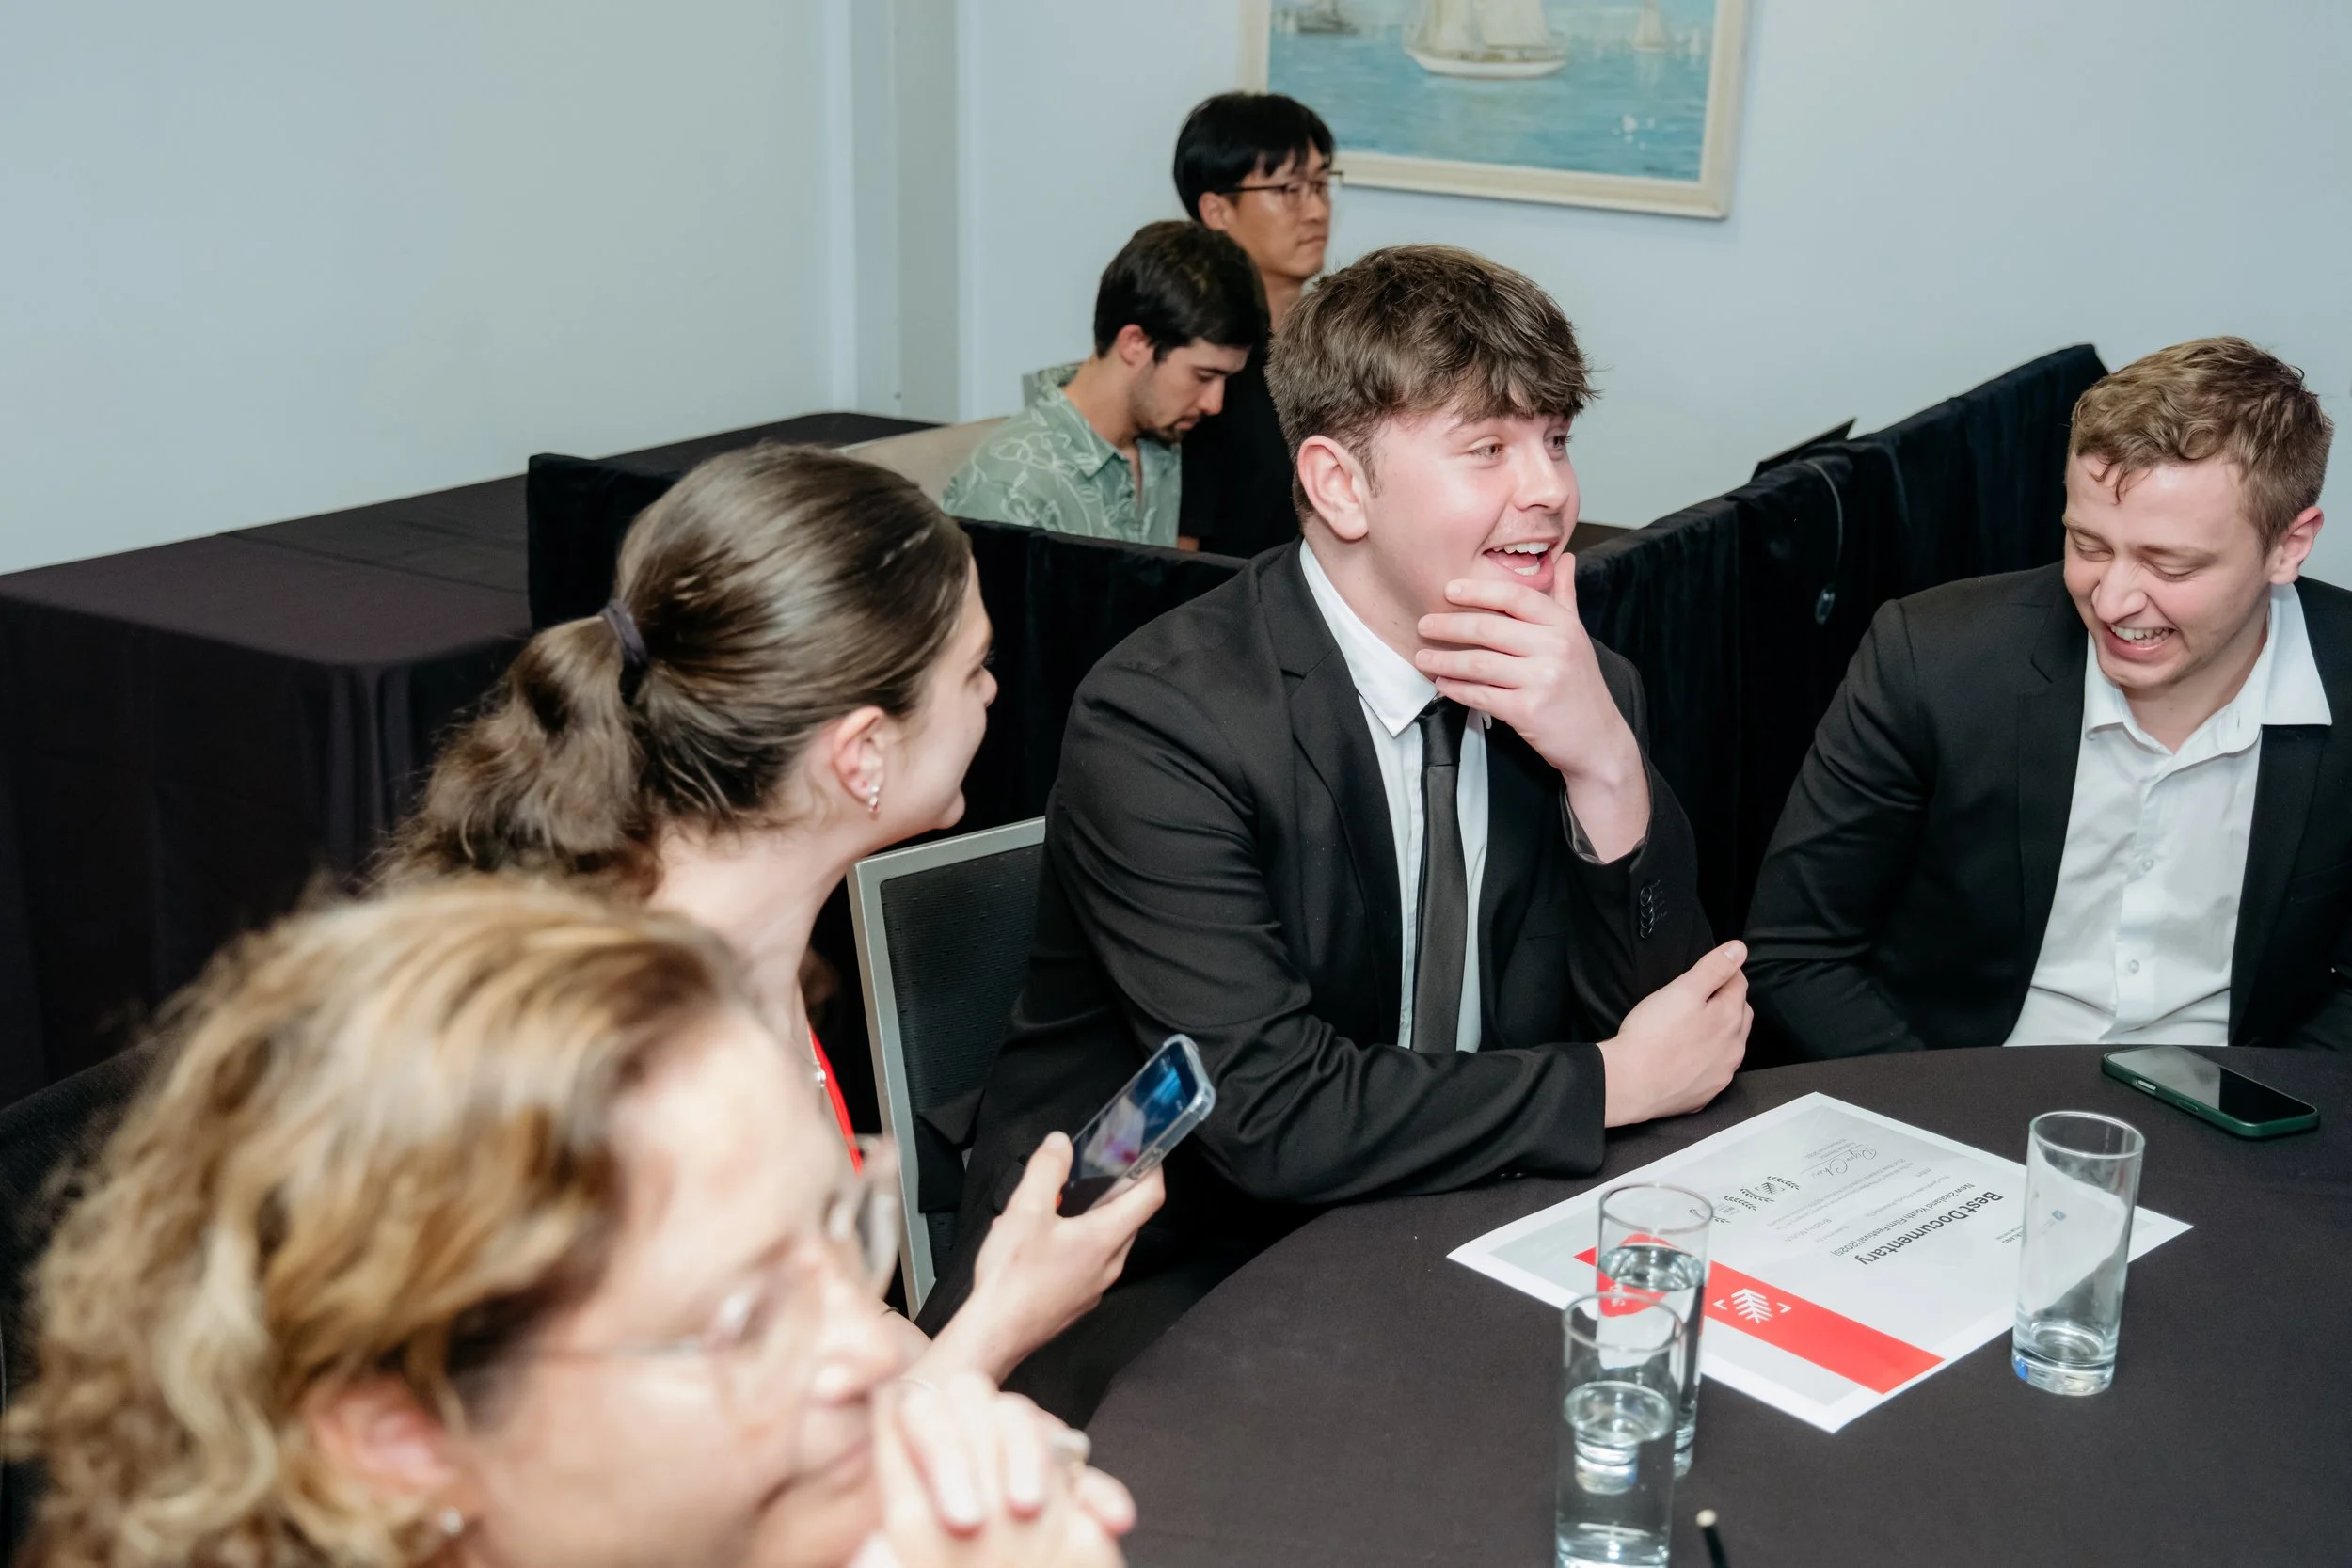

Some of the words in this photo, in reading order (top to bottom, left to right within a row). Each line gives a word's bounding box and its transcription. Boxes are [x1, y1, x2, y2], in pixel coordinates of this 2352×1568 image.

[1954, 1183, 1975, 1193] New
[1925, 1192, 1959, 1209] Zealand
[1959, 1192, 2003, 1212] Best
[1903, 1208, 1930, 1218] Youth
[1886, 1218, 1907, 1227] Film
[1854, 1210, 1969, 1265] Documentary
[1857, 1227, 1890, 1243] Festival
[1830, 1241, 1862, 1256] (2025)
